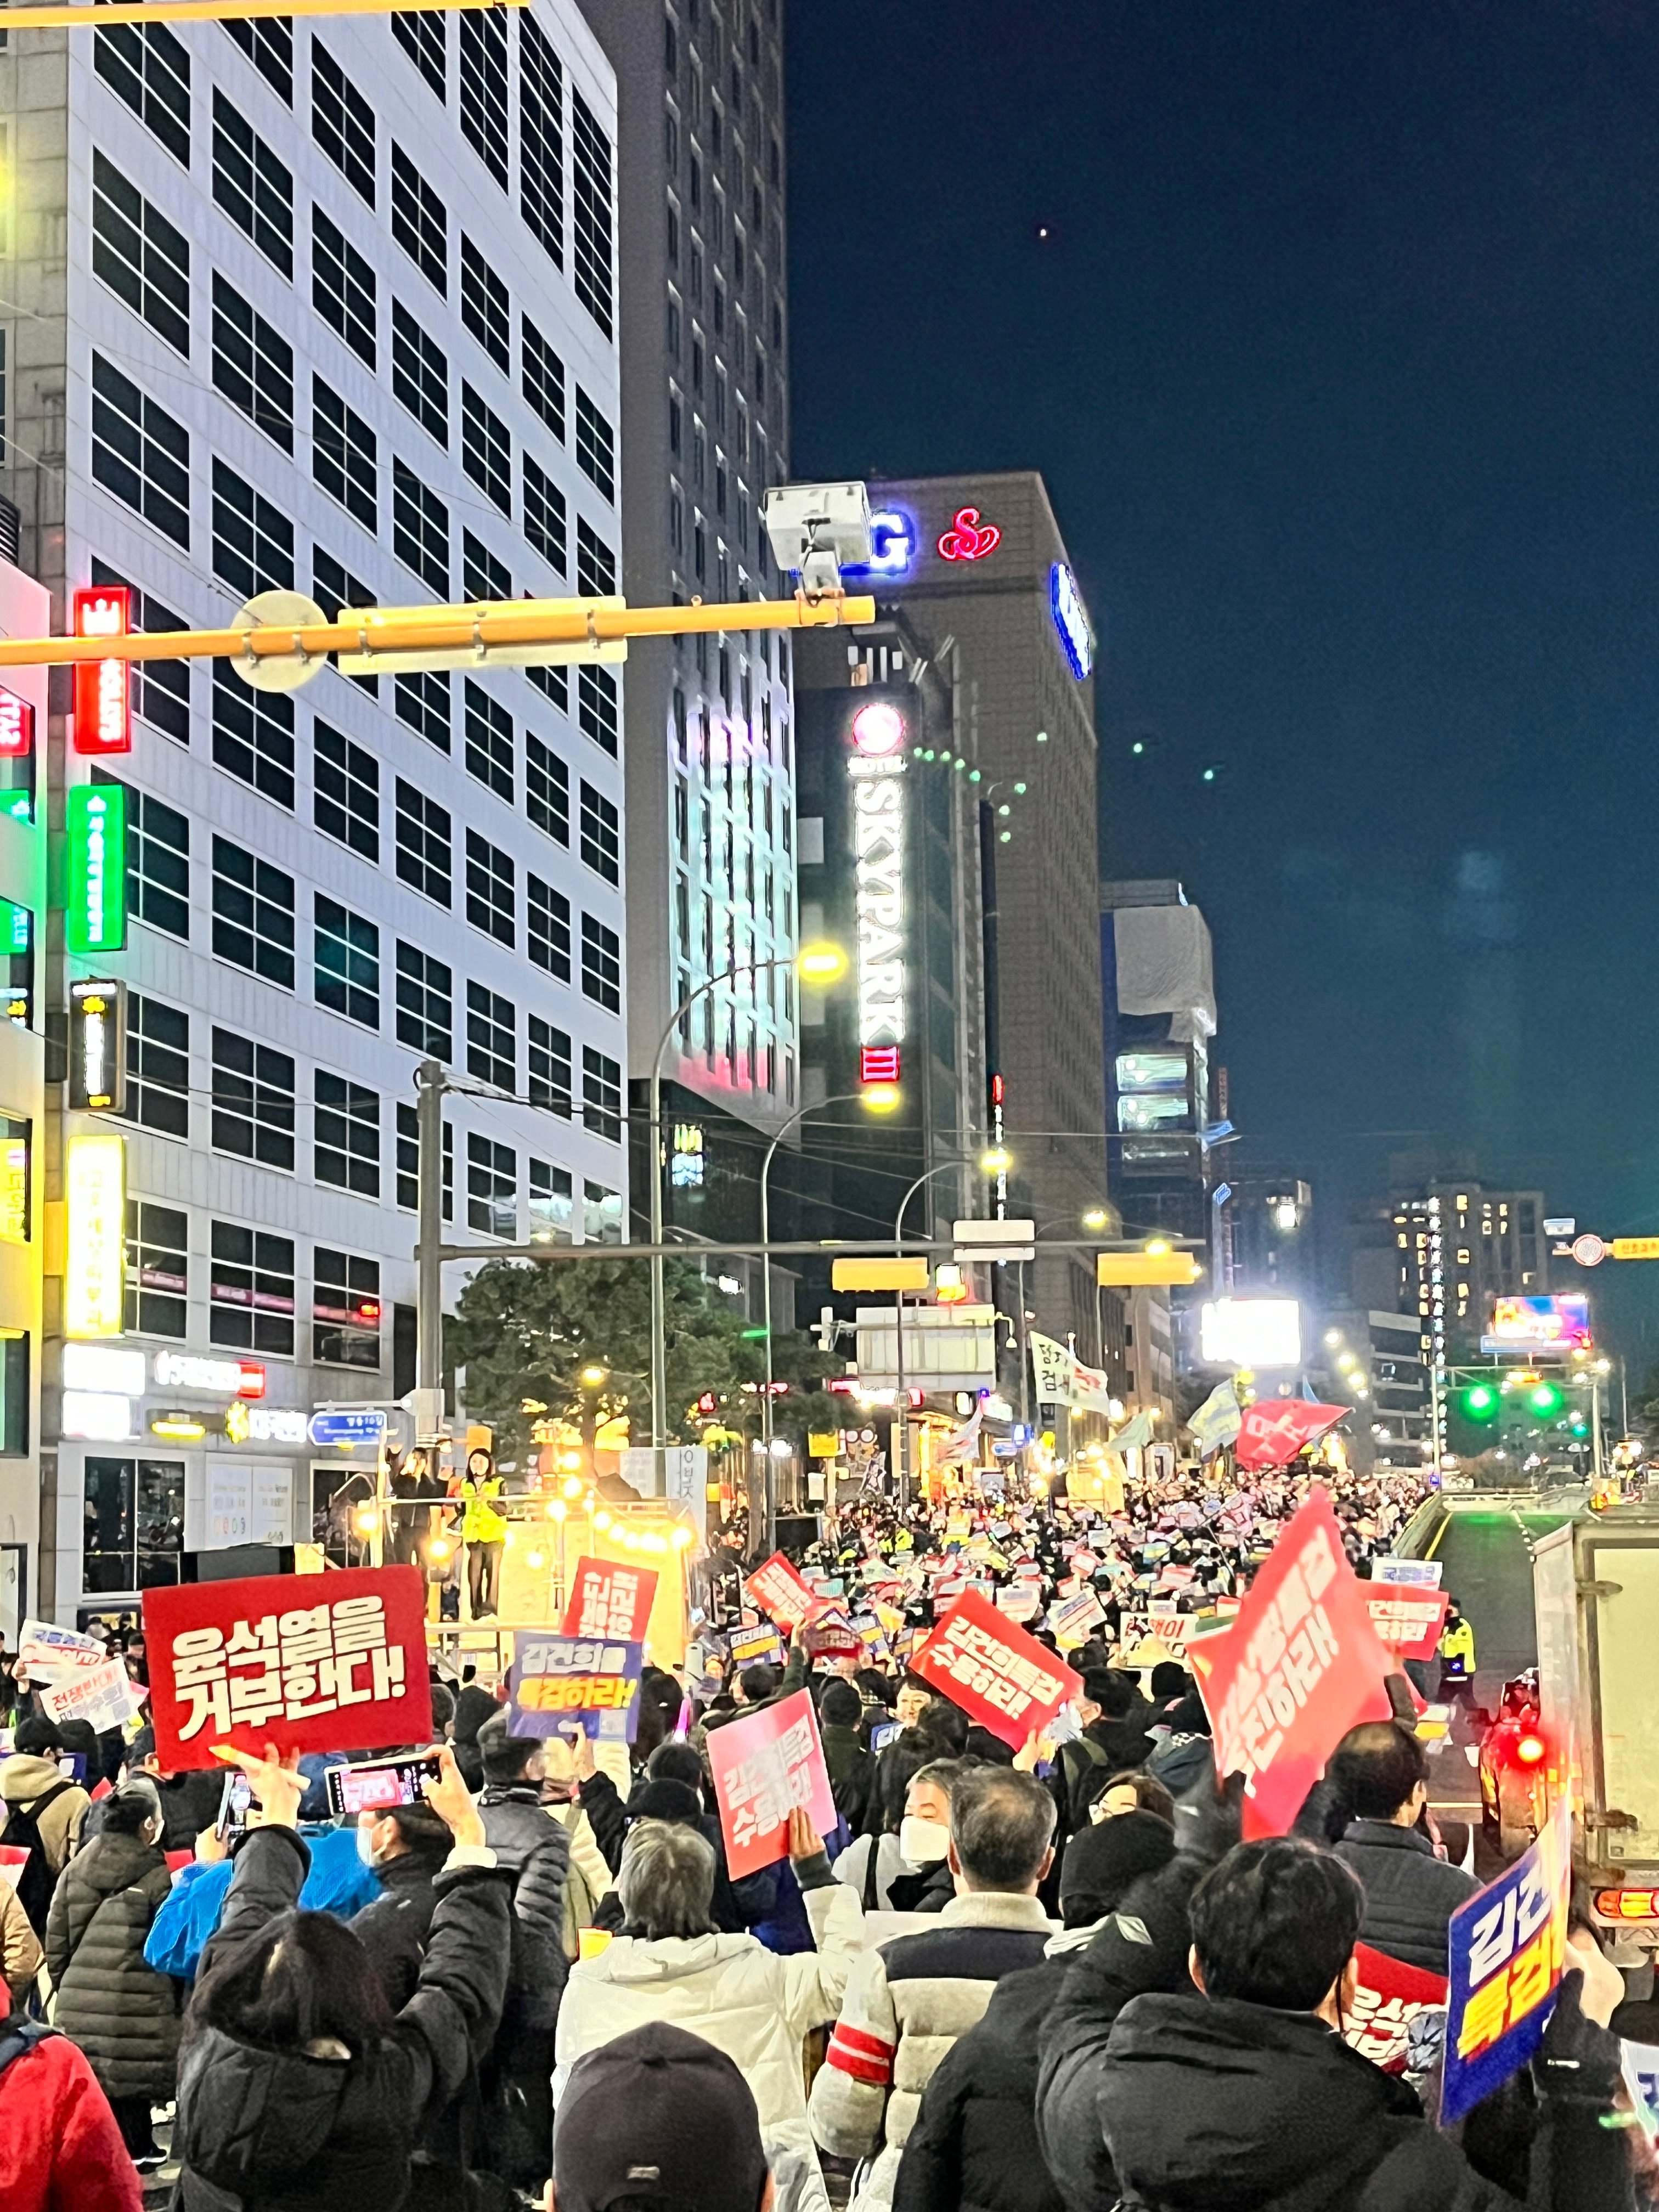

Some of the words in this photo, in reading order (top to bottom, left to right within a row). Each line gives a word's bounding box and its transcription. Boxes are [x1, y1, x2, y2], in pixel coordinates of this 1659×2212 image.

[854, 780, 904, 1045] SKYPARK
[173, 1595, 386, 1690] 윤석열을
[929, 1643, 1032, 1720] 수용하라!
[944, 1615, 1064, 1706] 김건희특검
[177, 1645, 405, 1741] 거부한다!
